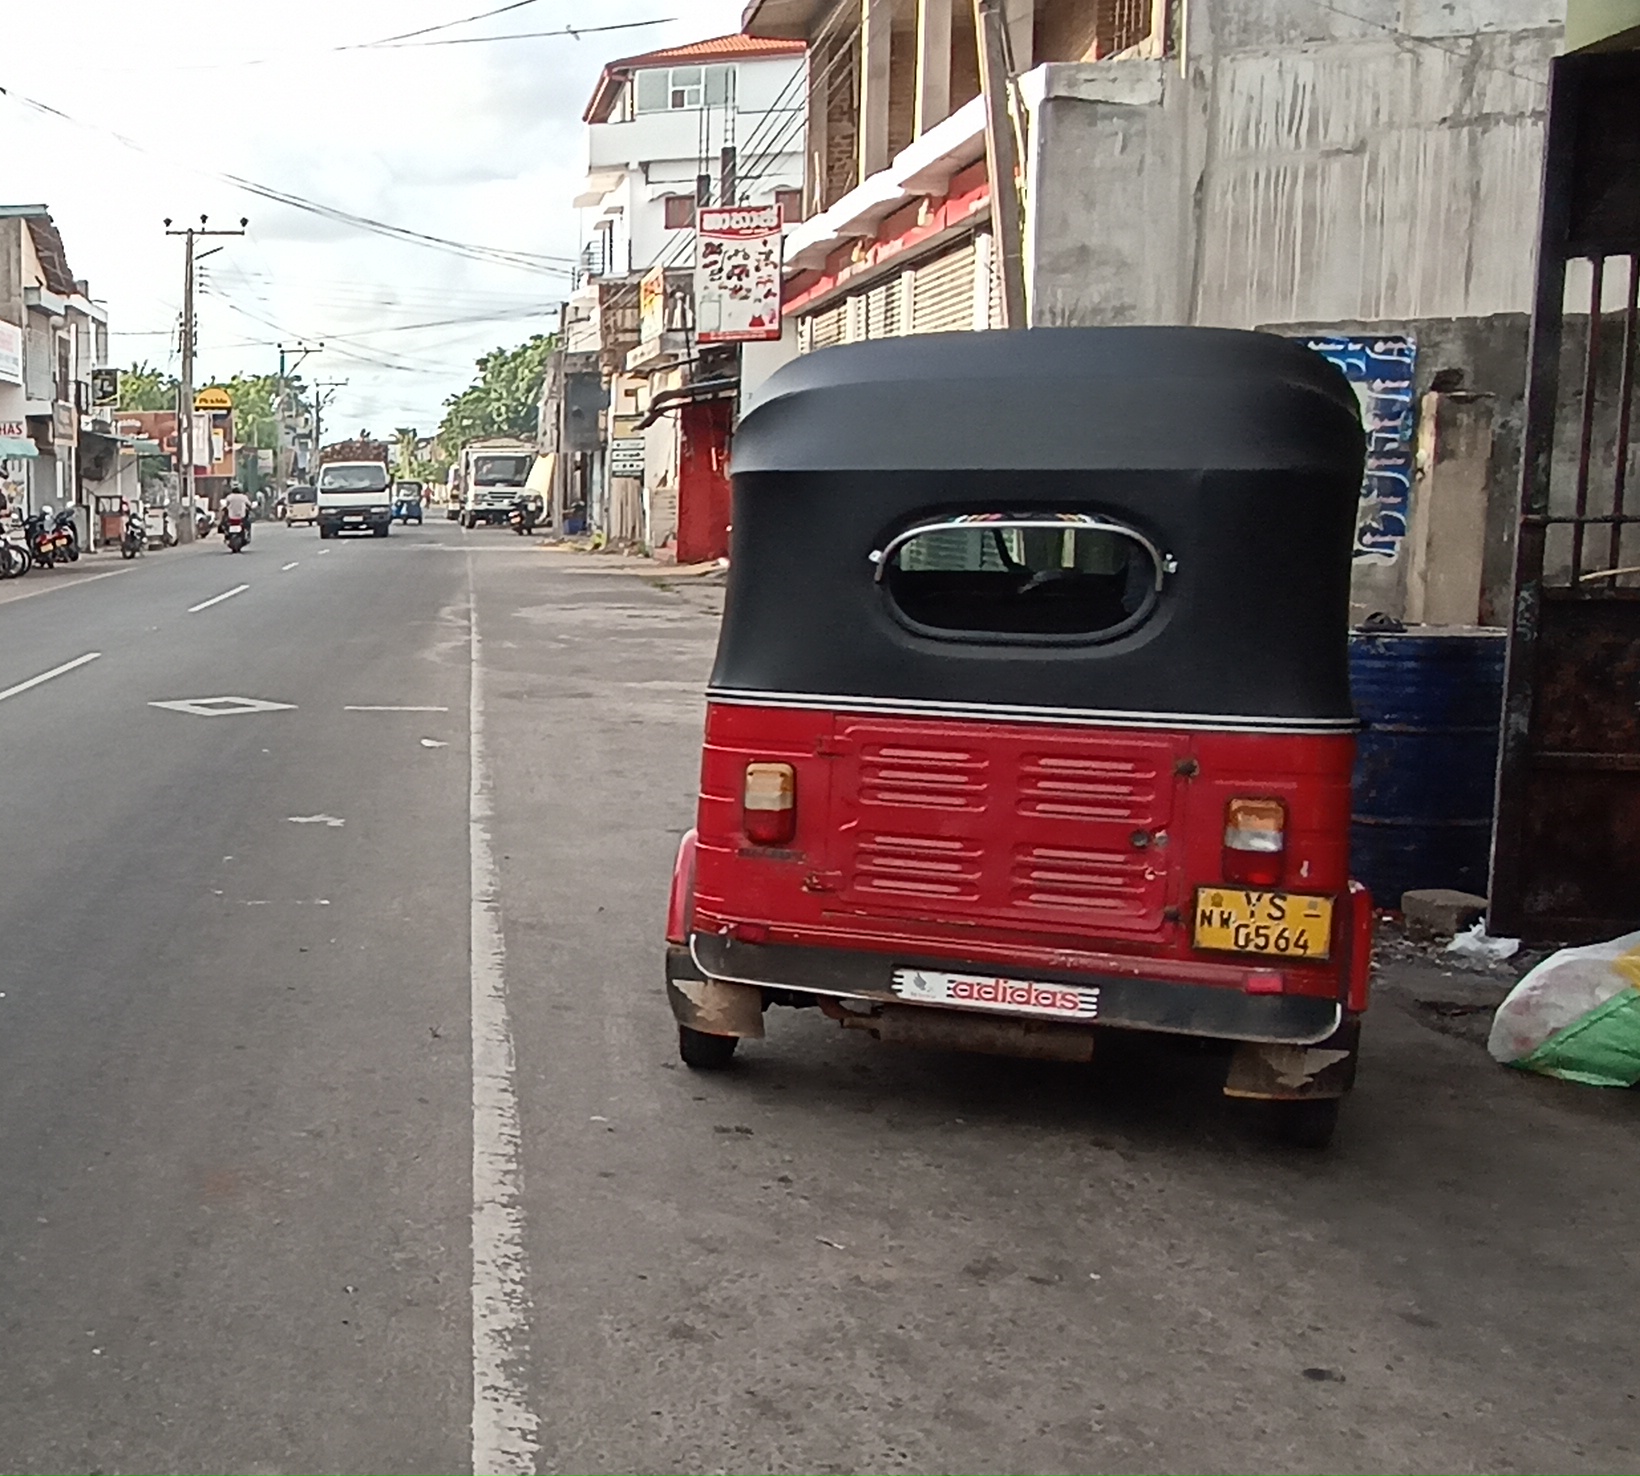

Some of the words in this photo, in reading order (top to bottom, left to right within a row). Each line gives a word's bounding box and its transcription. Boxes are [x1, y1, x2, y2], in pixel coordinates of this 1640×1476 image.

[1244, 892, 1288, 921] YS
[1233, 923, 1310, 956] 0564
[952, 978, 1080, 1011] adidas
